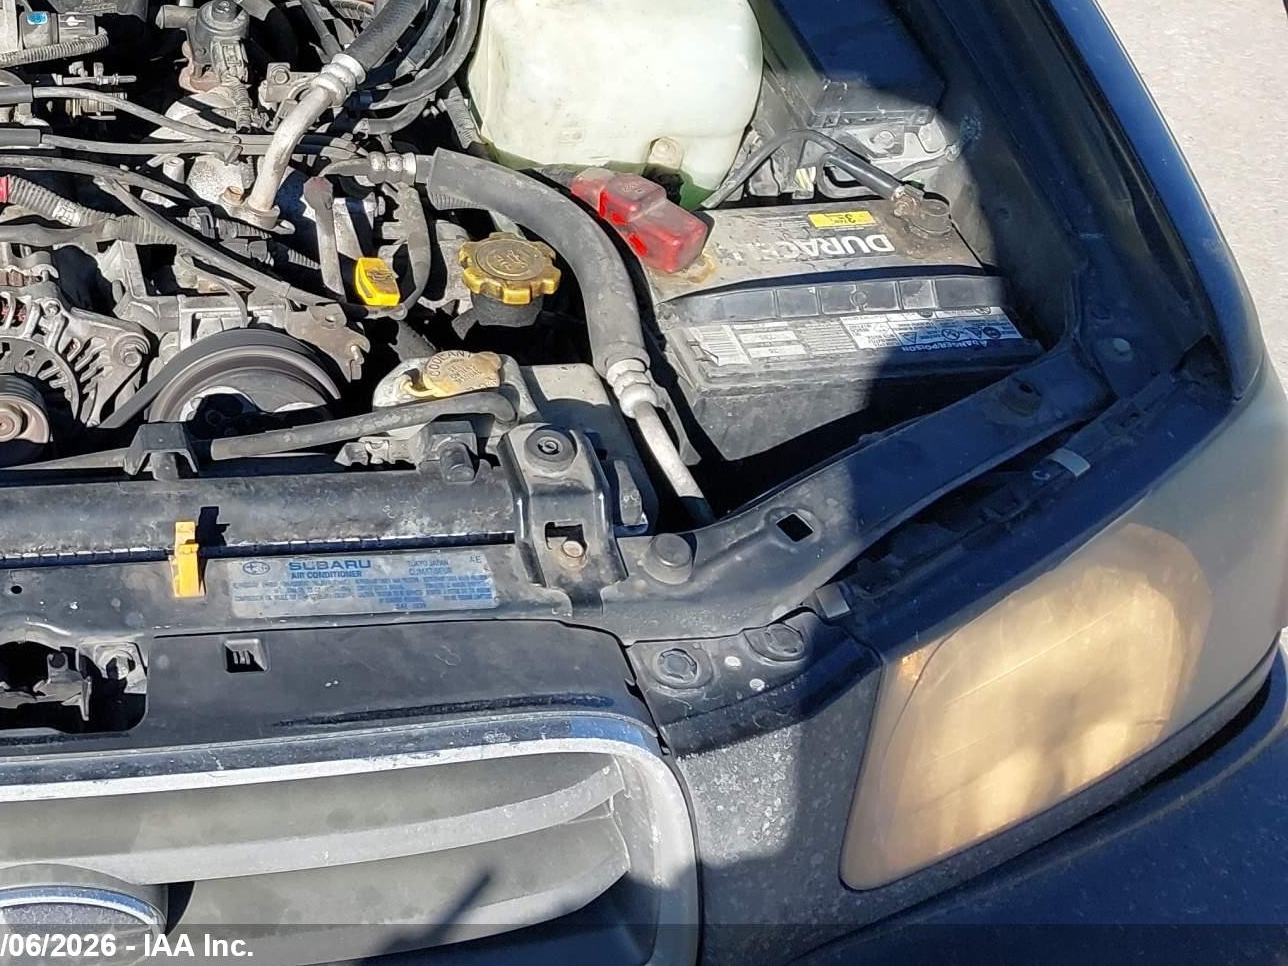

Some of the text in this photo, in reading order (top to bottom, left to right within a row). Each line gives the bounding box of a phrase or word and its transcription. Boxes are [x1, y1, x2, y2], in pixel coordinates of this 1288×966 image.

[846, 214, 856, 223] 3
[764, 234, 895, 259] DURAC
[428, 350, 471, 377] COOLANT
[288, 559, 371, 571] SUBARU
[291, 570, 362, 580] AIR CONDITIONER
